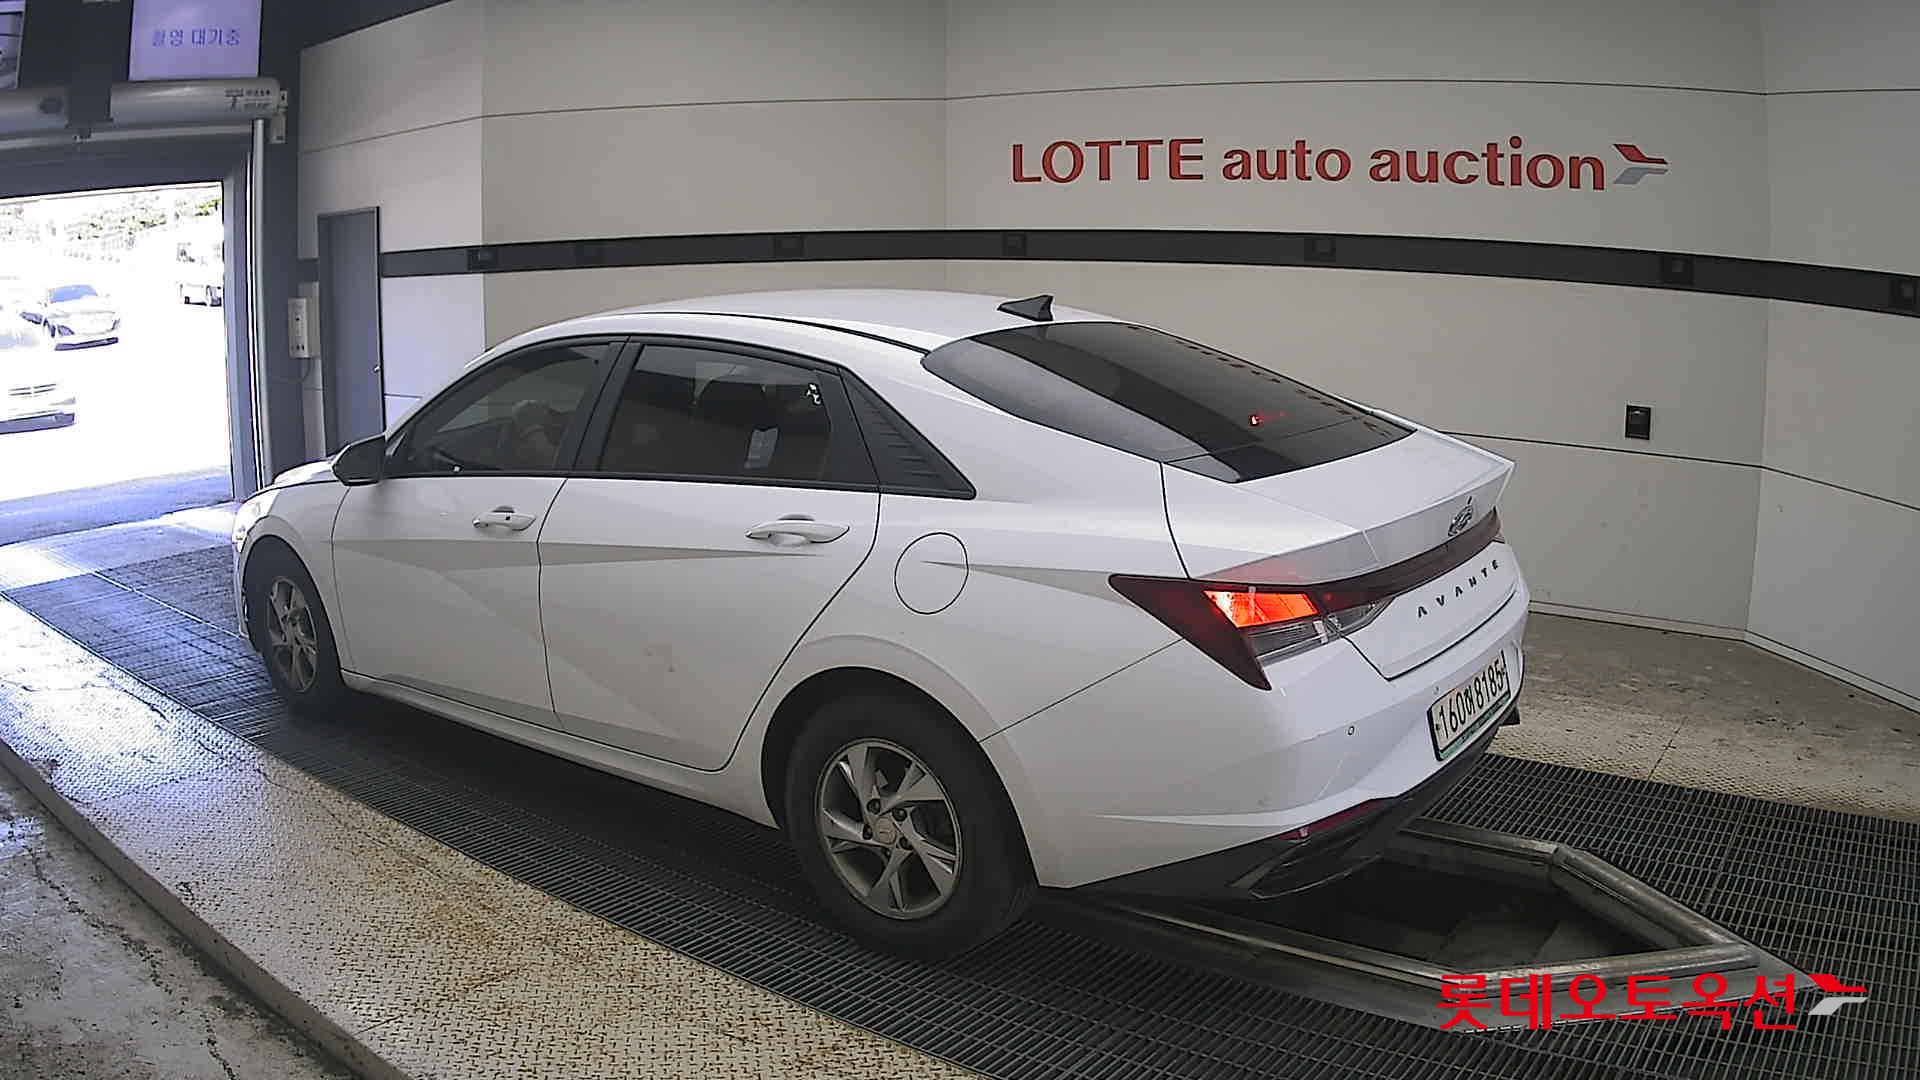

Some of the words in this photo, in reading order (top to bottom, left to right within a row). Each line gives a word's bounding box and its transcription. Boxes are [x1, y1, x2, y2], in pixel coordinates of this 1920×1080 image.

[1011, 138, 1204, 184] LOTTE
[1222, 140, 1352, 182] auto
[1368, 136, 1606, 191] auction
[1417, 559, 1499, 618] AVANTE
